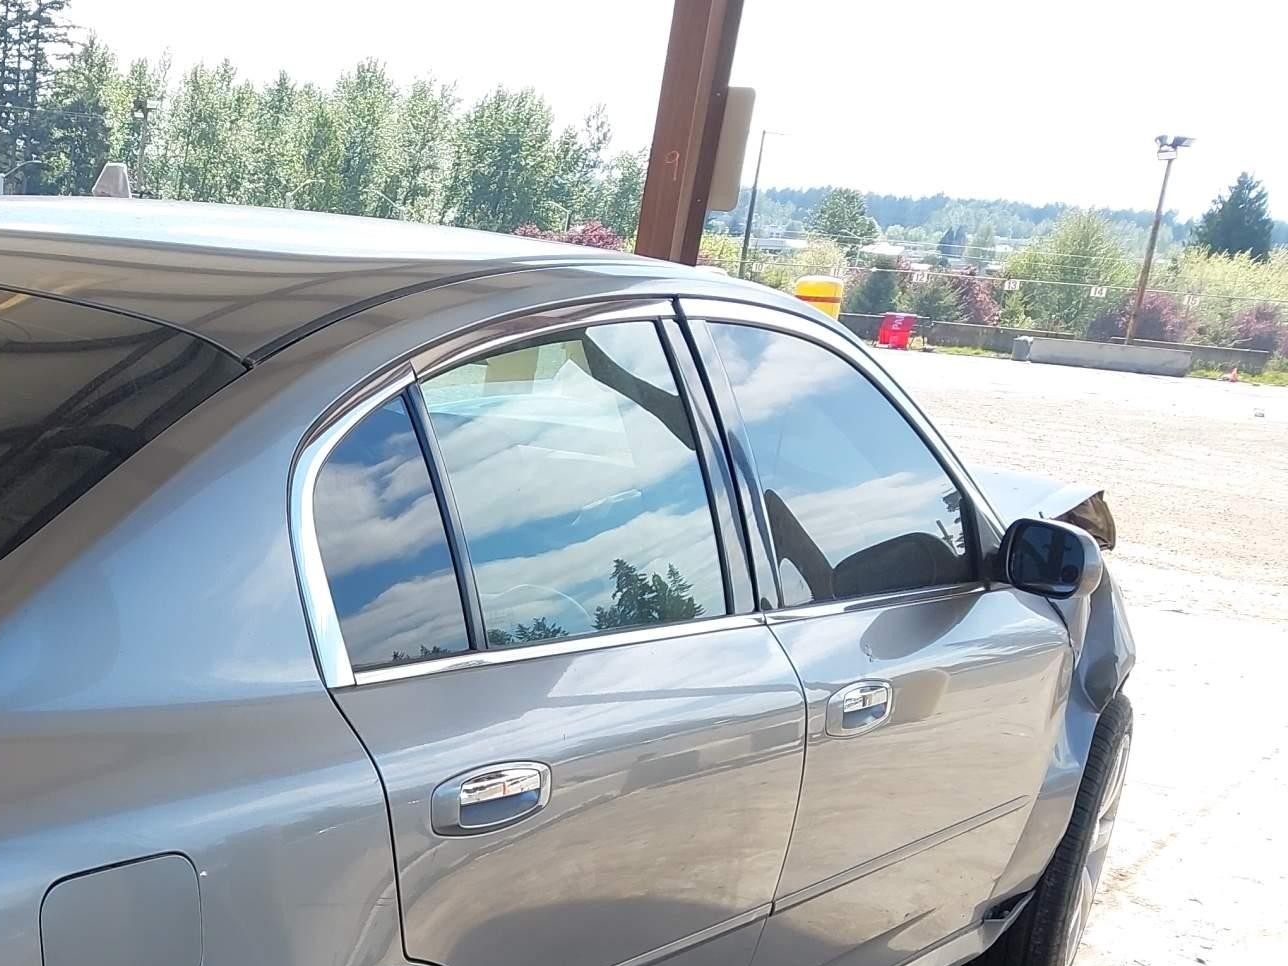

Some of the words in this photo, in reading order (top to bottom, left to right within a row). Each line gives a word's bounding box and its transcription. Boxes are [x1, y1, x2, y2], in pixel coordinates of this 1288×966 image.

[663, 150, 680, 181] 9
[754, 263, 763, 272] 10
[915, 272, 925, 282] 12
[1007, 280, 1017, 290] 13
[1094, 287, 1103, 296] 14
[1186, 295, 1198, 305] 15
